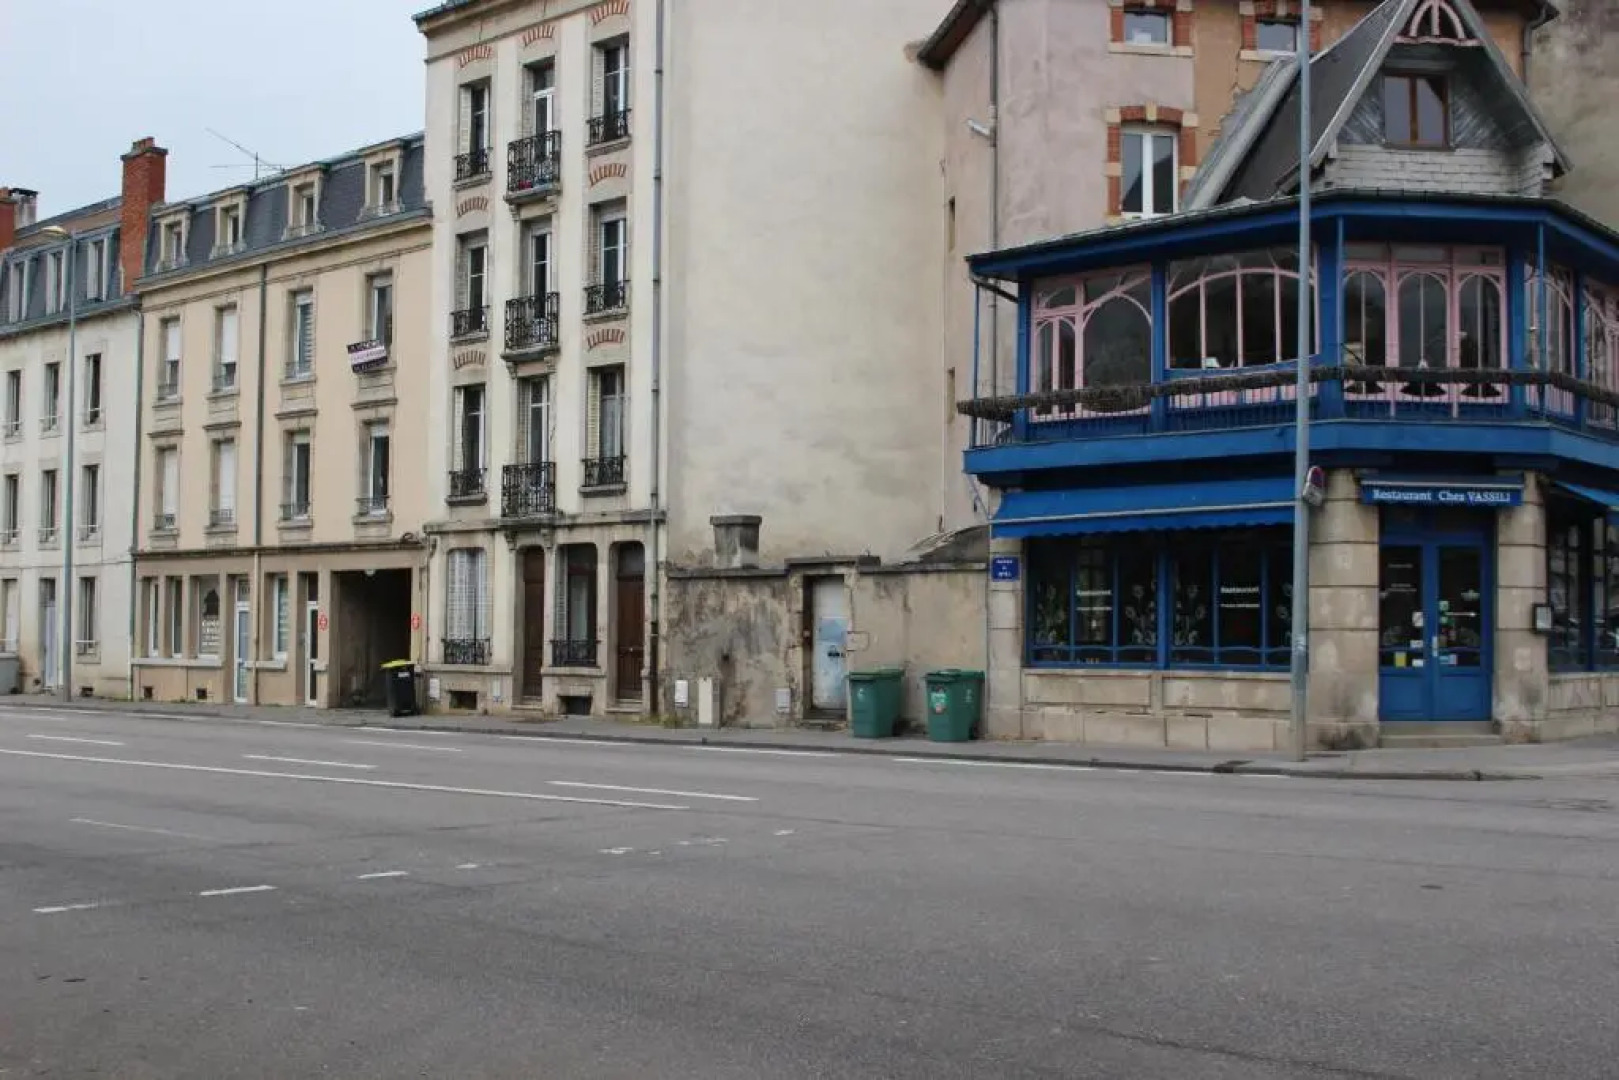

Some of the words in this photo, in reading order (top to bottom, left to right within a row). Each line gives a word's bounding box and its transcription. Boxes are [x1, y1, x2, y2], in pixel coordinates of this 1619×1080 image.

[1373, 489, 1432, 501] Restaurant
[1438, 490, 1465, 502] Chez
[1467, 491, 1511, 503] VASSILI
